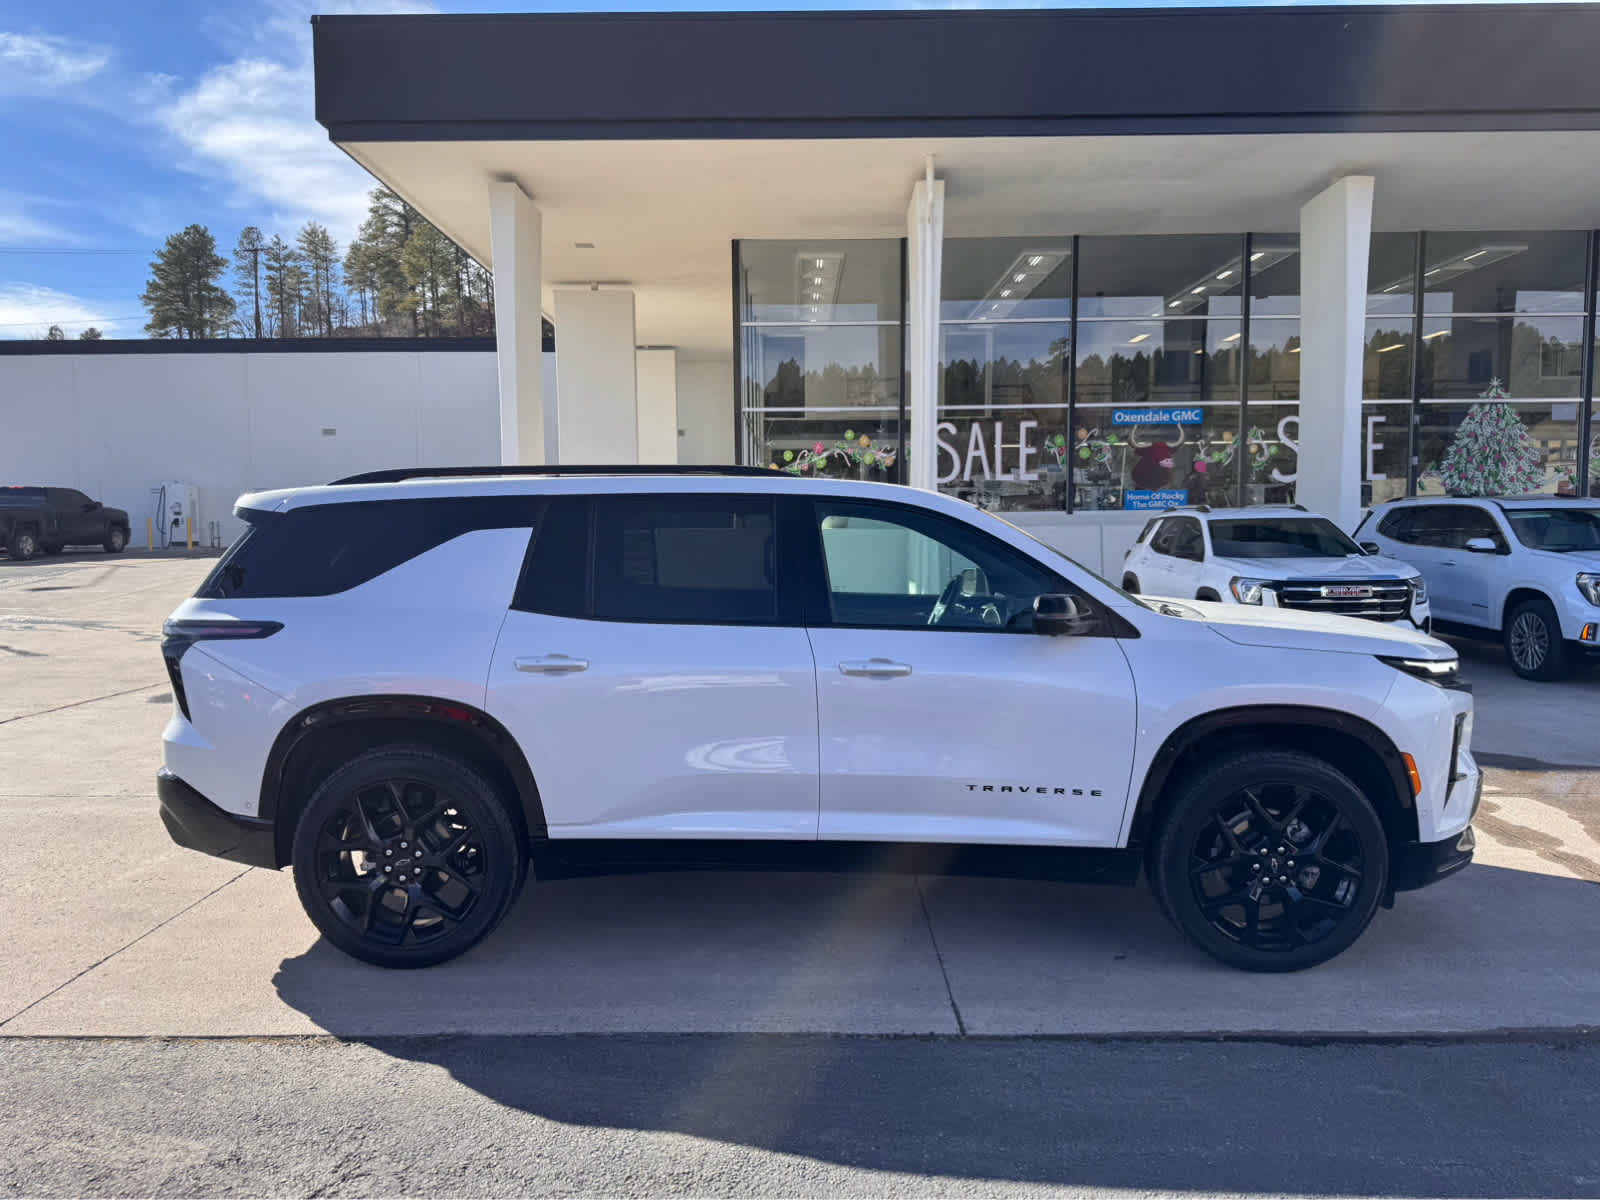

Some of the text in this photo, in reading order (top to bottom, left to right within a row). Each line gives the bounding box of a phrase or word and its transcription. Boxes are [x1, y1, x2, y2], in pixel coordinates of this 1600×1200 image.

[1114, 409, 1201, 423] Oxendale GMC
[936, 420, 1039, 484] SALE
[1127, 492, 1150, 501] Home
[1161, 491, 1185, 502] Rocky
[965, 784, 1103, 797] TRAVERSE
